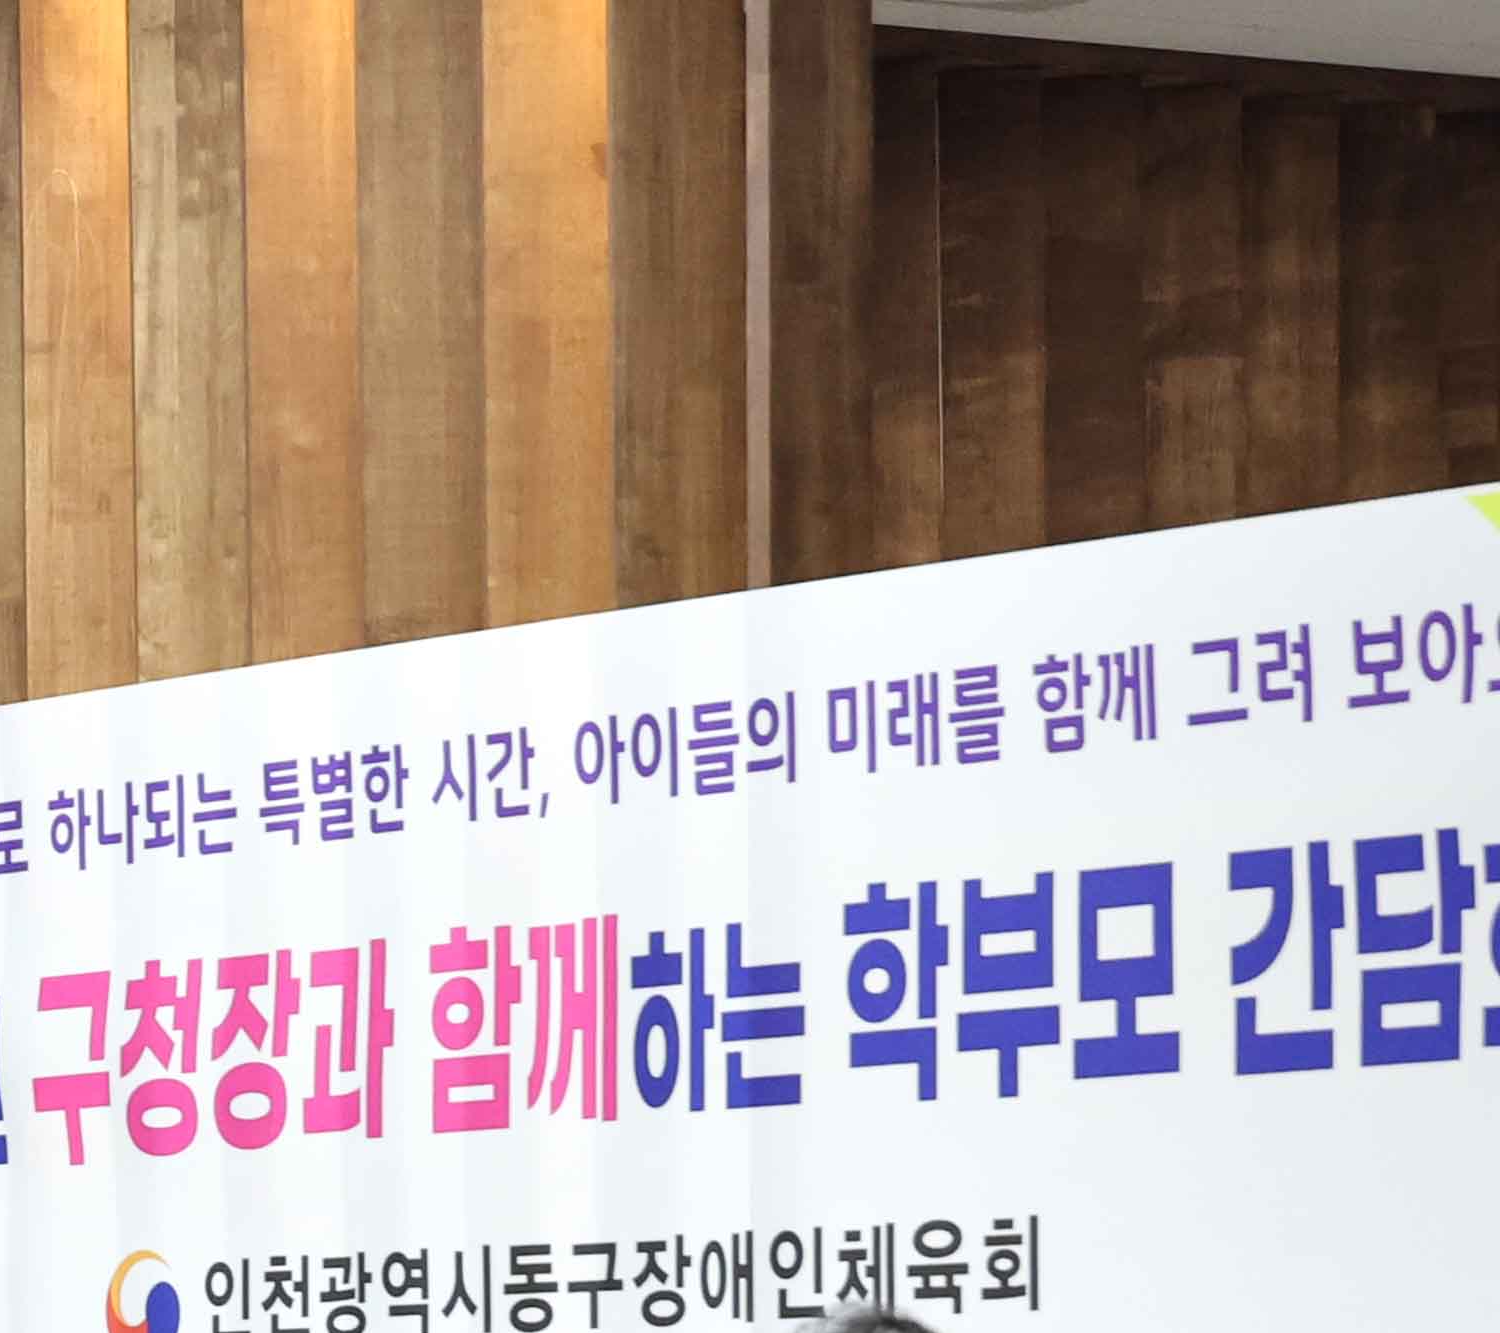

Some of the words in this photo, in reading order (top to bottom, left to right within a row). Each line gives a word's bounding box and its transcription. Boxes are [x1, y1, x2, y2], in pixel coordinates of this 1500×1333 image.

[48, 773, 238, 870] 하나되는
[259, 744, 409, 842] 특별한
[432, 729, 552, 820] 시간,
[575, 691, 797, 804] 아이들의
[827, 664, 1006, 772] 미래를
[1032, 643, 1158, 754] 함께
[1187, 622, 1314, 726] 그려
[1348, 603, 1500, 709] 보아
[31, 937, 396, 1167] 구청장과
[429, 913, 806, 1135] 함께하는
[843, 861, 1181, 1103] 학부모
[1228, 827, 1500, 1077] 간담
